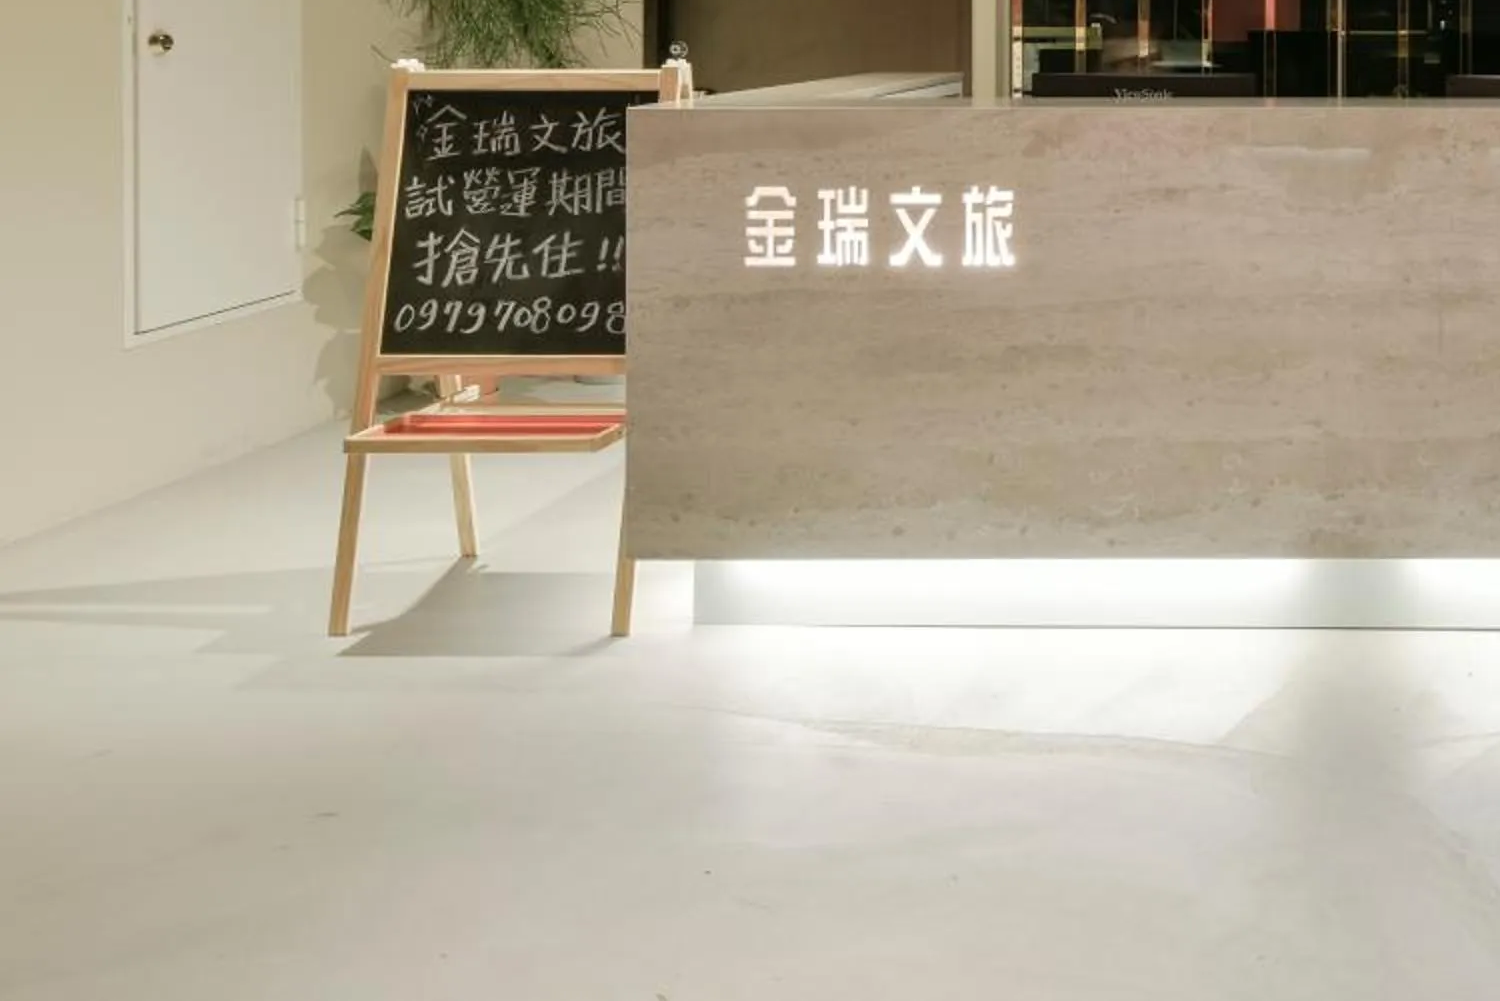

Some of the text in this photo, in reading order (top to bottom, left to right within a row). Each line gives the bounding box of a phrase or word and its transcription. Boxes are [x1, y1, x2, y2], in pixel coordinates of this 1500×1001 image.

[427, 105, 626, 161] 金瑞文旅
[404, 166, 626, 219] 試營運期間
[744, 185, 1016, 267] 金瑞文旅
